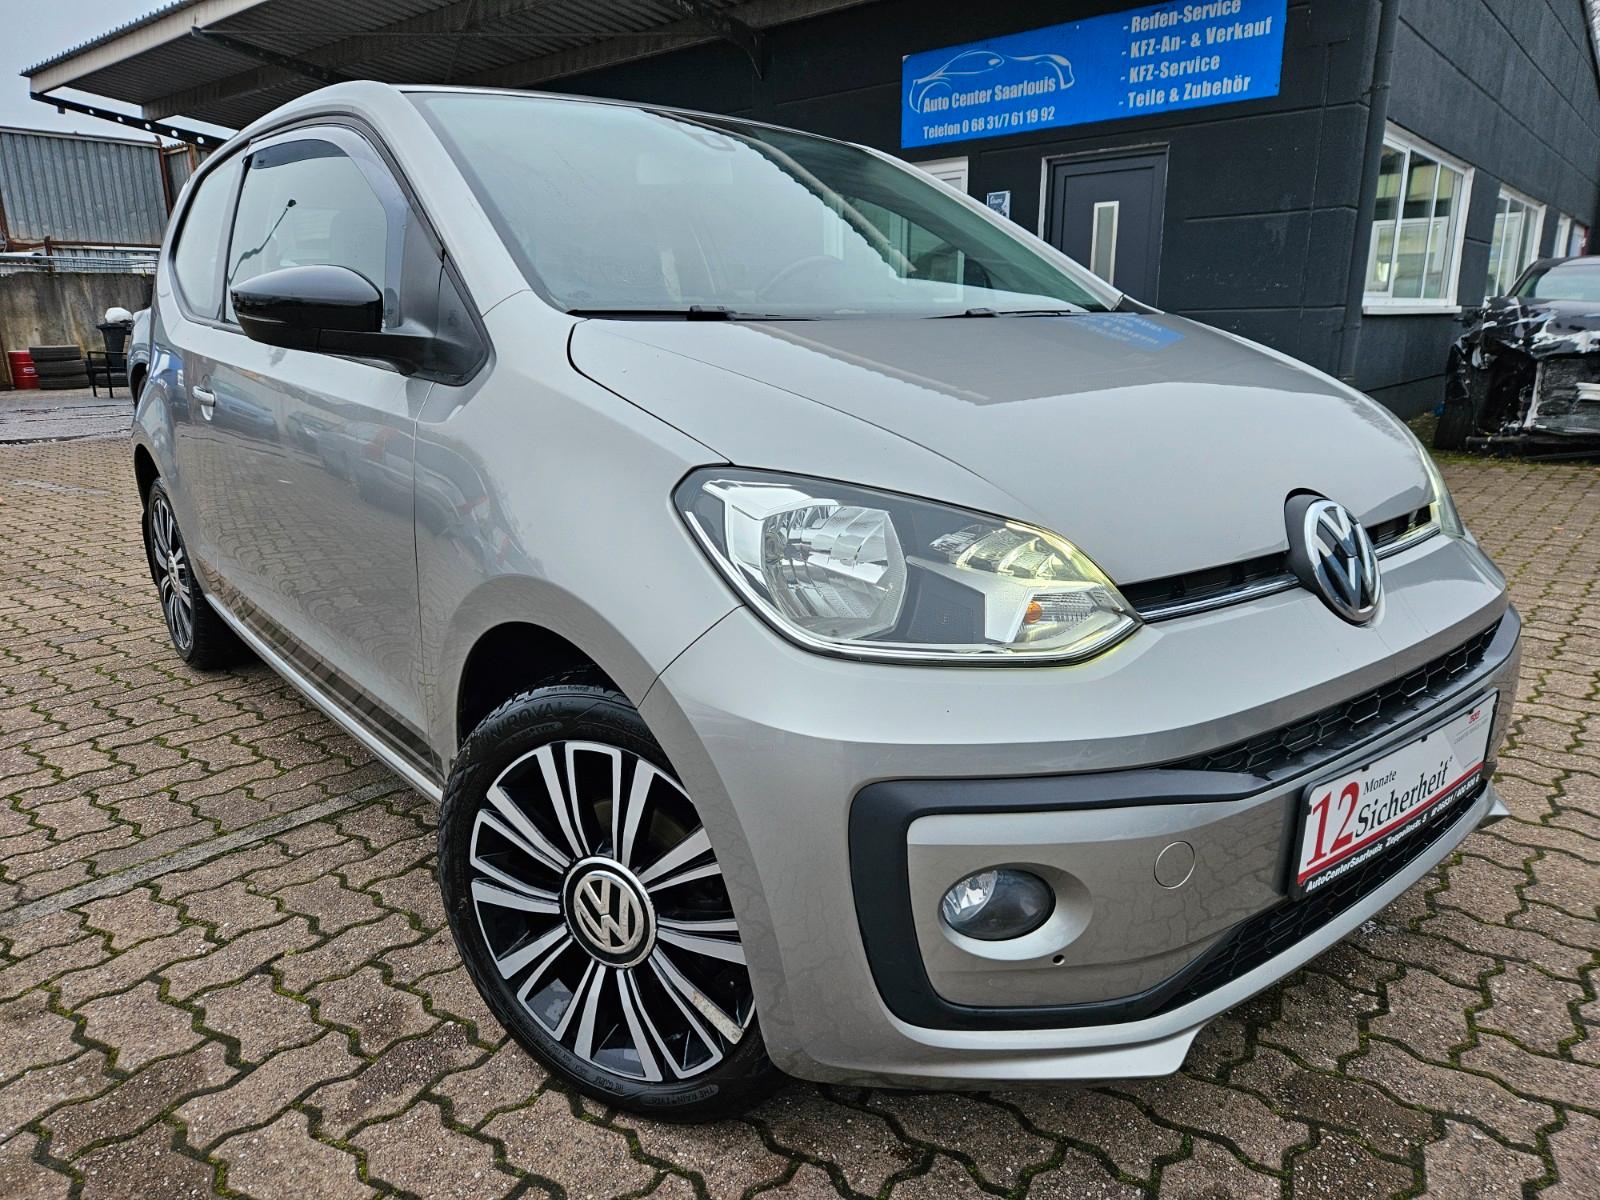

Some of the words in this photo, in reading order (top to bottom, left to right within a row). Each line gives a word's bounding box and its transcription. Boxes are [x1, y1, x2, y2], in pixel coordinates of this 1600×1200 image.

[1130, 0, 1242, 33] Reifen-Service
[1130, 35, 1187, 59] KFZ-An-
[1190, 32, 1201, 48] &
[1206, 16, 1273, 45] Verkauf
[1129, 54, 1221, 84] KFZ-Service
[923, 97, 950, 113] Auto
[951, 88, 992, 108] Center
[994, 76, 1056, 101] Saarlouis
[1128, 88, 1165, 109] Teile
[1169, 87, 1180, 103] &
[1183, 74, 1251, 100] Zubehör
[923, 122, 960, 139] Telefon
[962, 119, 969, 133] 0
[971, 117, 985, 132] 68
[986, 113, 1009, 130] 31/7
[1011, 111, 1024, 126] 61
[1026, 108, 1039, 123] 19
[1040, 106, 1055, 122] 92
[1355, 760, 1449, 838] Sicherheit
[1363, 770, 1397, 795] Monate
[1306, 781, 1360, 867] 12
